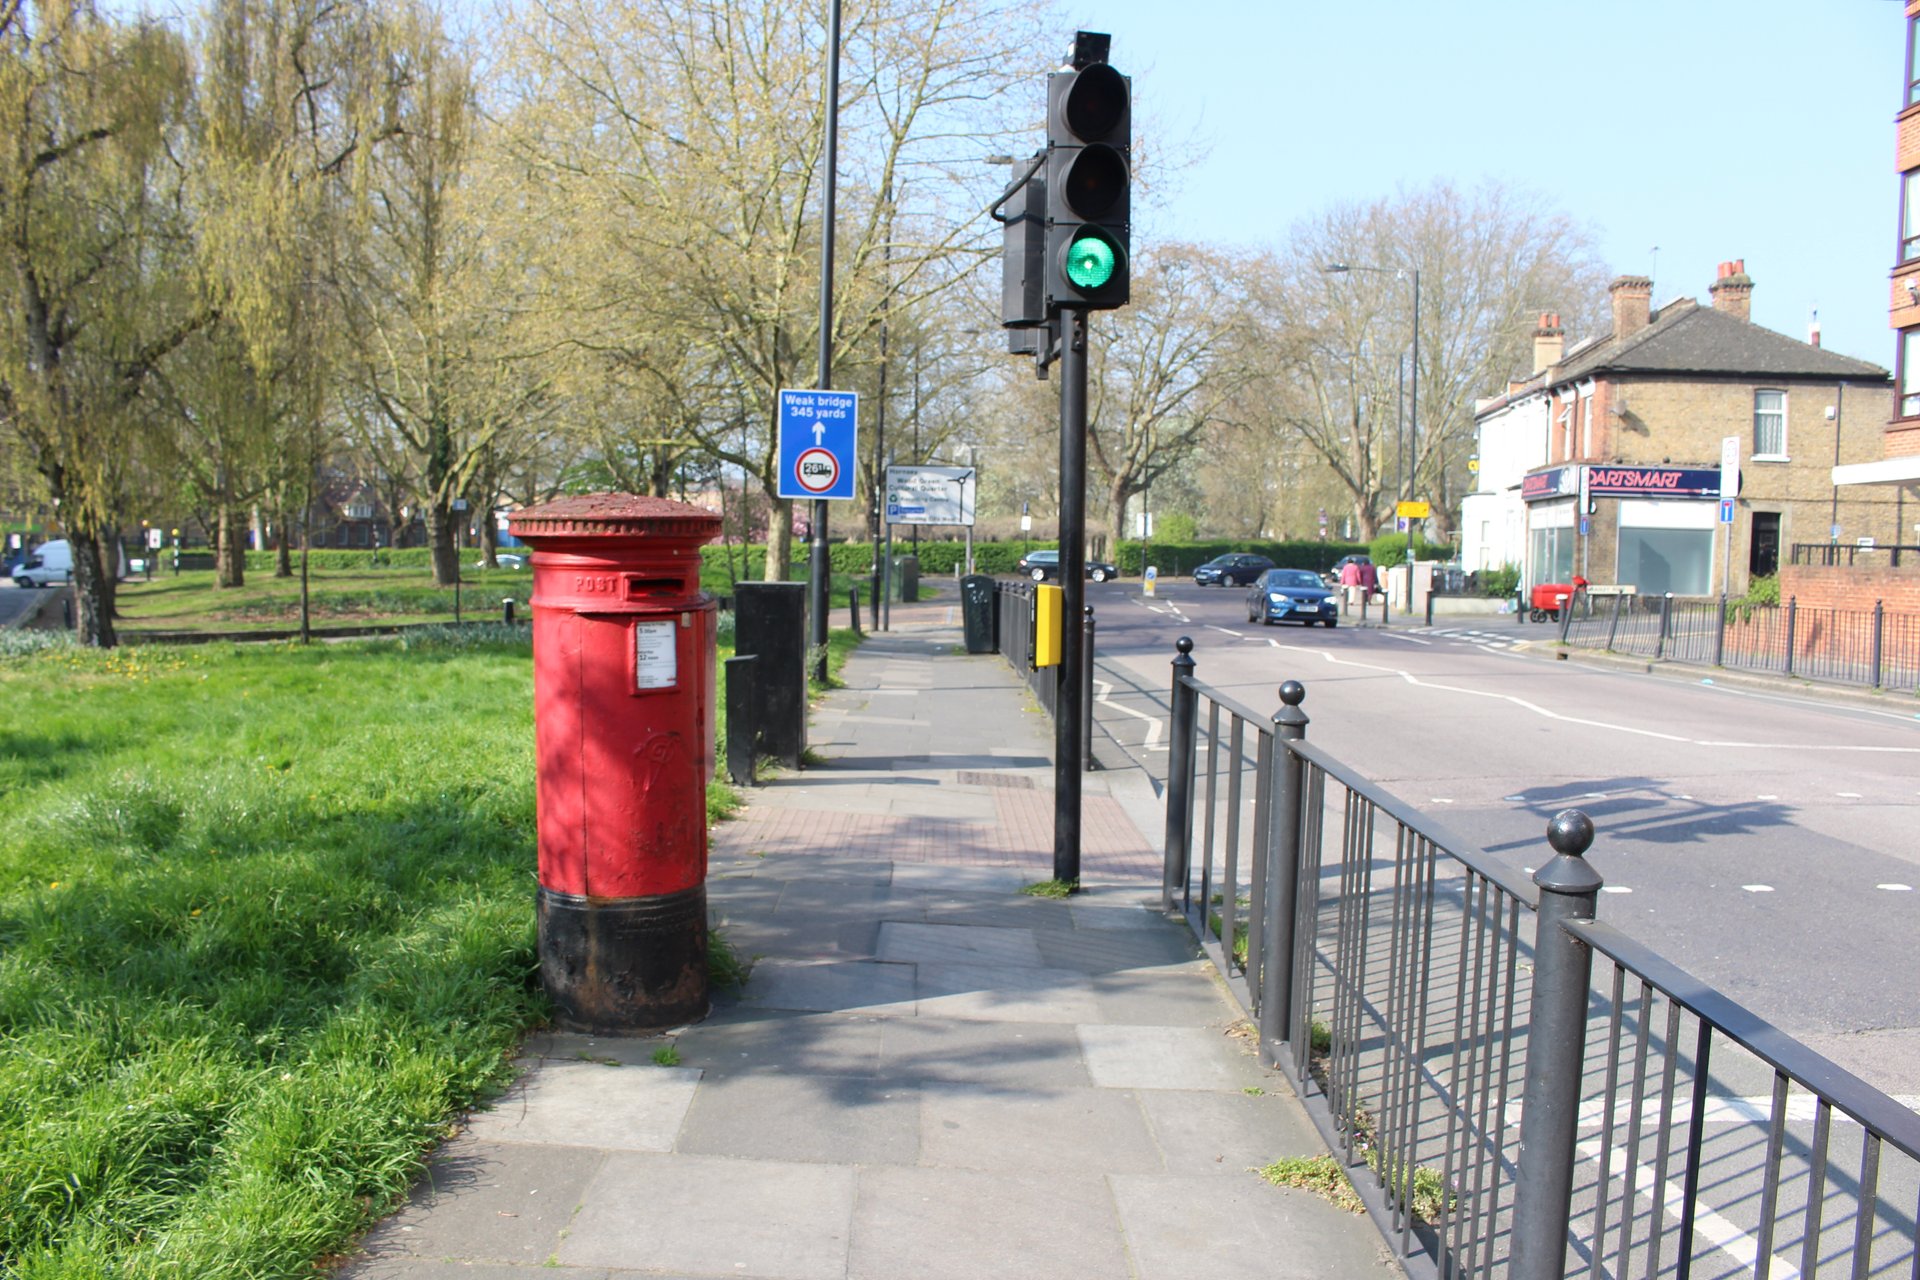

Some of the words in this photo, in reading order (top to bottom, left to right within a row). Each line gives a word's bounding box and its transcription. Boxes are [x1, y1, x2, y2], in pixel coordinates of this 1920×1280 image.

[784, 394, 815, 406] Weak
[818, 395, 853, 409] bridge
[790, 406, 814, 418] 345
[815, 408, 846, 420] yards
[576, 575, 618, 592] POST
